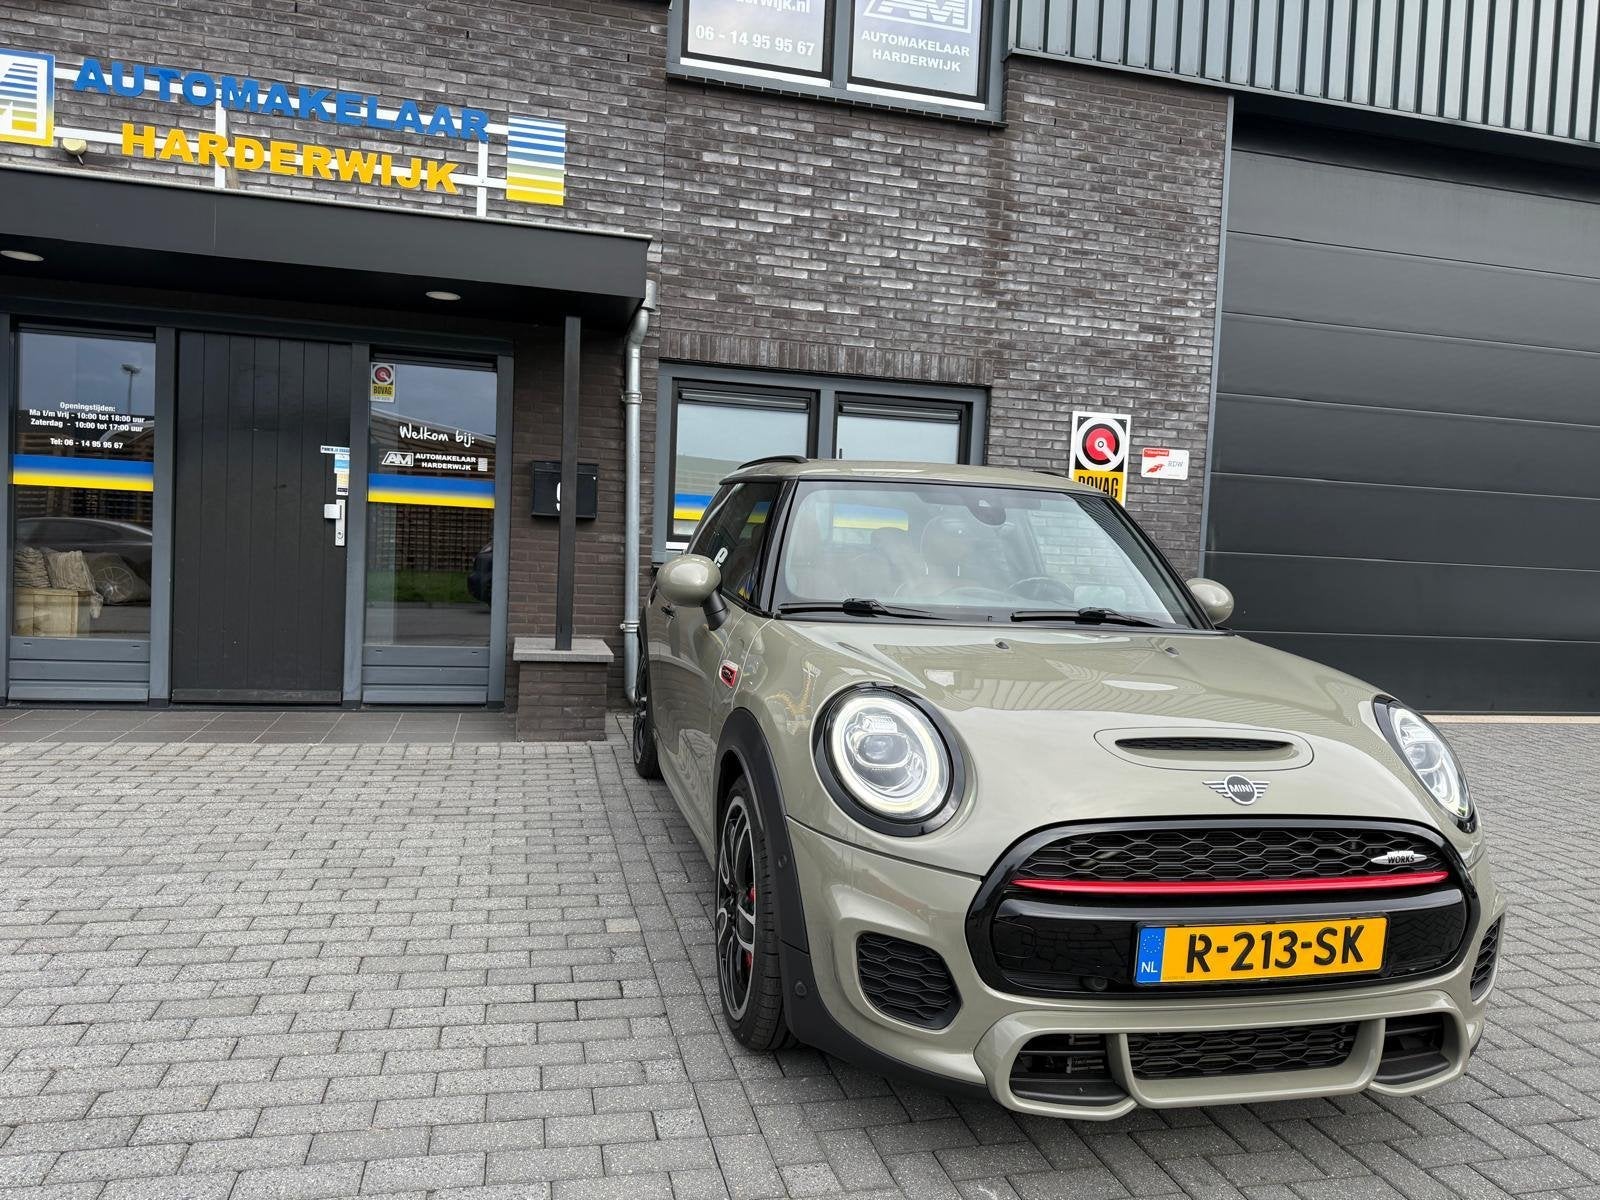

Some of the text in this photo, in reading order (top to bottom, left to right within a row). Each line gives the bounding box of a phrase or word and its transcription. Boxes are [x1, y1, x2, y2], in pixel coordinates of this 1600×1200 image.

[695, 24, 714, 41] 06
[730, 30, 748, 46] 14
[752, 33, 771, 49] 95
[775, 37, 793, 53] 95
[797, 40, 815, 56] 67
[861, 30, 970, 56] AUTOMAKELAAR
[872, 48, 961, 72] HARDERWIJK
[72, 57, 489, 144] AUTOMAKELAAR
[121, 122, 459, 194] HARDERWIJK
[373, 385, 392, 396] BOVAG
[59, 401, 116, 412] Openingstijden:
[57, 411, 69, 419] Vrij
[77, 412, 97, 420] 10:00
[31, 418, 63, 428] Zaterdag
[75, 421, 95, 429] 10:00
[399, 423, 475, 448] Welkom bij:
[64, 438, 74, 446] 06
[92, 440, 101, 448] 95
[415, 453, 477, 463] AUTOMAKELAAR
[421, 462, 471, 471] HARDERWIJK
[1228, 783, 1254, 793] MINI
[1387, 854, 1415, 864] WORKS
[1186, 924, 1365, 974] R-213-SK
[1141, 962, 1158, 973] NL
